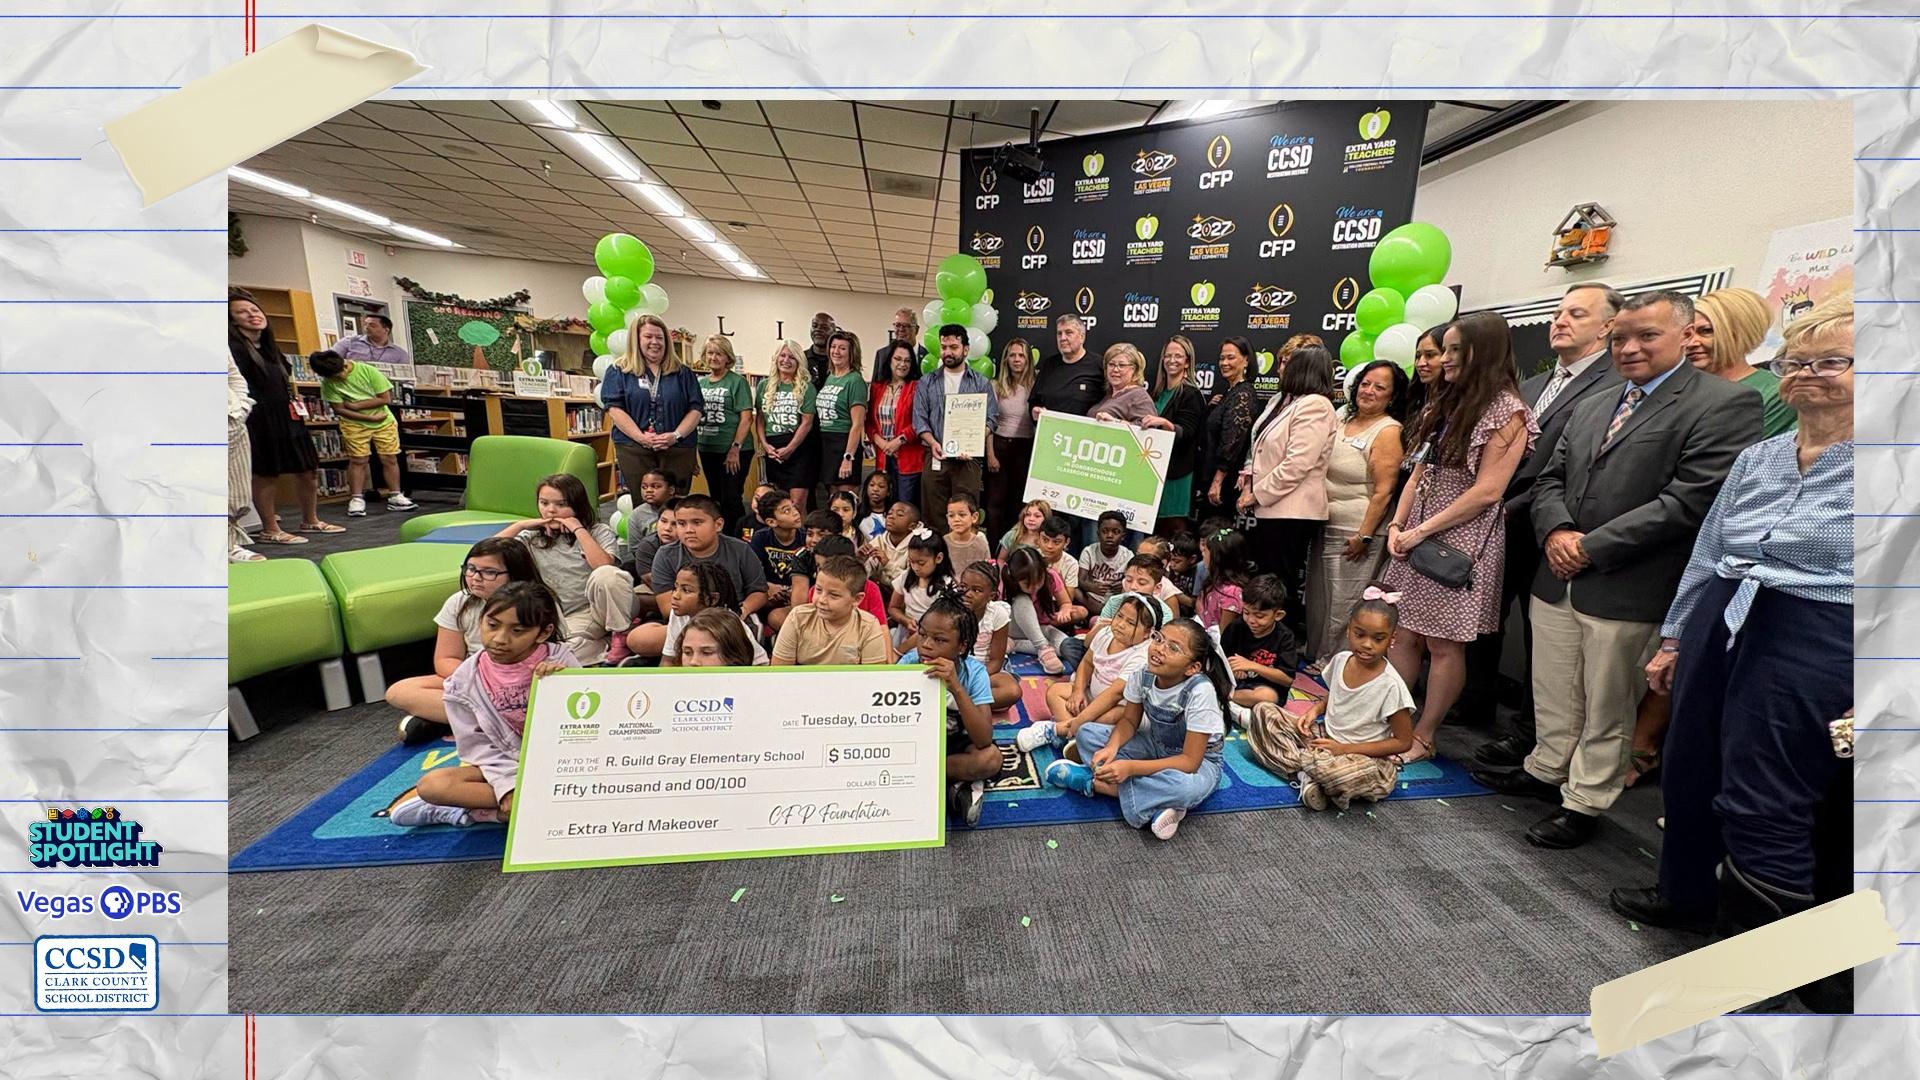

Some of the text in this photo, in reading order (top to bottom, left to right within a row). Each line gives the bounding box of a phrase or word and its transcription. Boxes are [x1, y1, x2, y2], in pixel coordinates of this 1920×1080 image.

[1270, 134, 1306, 147] We are
[1346, 139, 1396, 152] EXTRA YARD
[1268, 144, 1312, 171] CCSD
[1349, 148, 1395, 160] TEACHERS
[1136, 154, 1174, 173] 2027
[1134, 180, 1148, 190] LAS
[1148, 179, 1171, 190] VEGAS
[1200, 170, 1234, 190] CFP
[1024, 178, 1054, 198] CCSD
[1077, 184, 1109, 192] TEACHERS
[976, 196, 1000, 210] CFP
[1336, 206, 1374, 219] We are
[1073, 228, 1088, 240] We
[1192, 220, 1232, 238] 2027
[1332, 218, 1382, 243] CCSD
[973, 238, 1001, 250] 2027
[1072, 239, 1106, 258] CCSD
[1148, 240, 1164, 248] YARD
[1190, 247, 1204, 256] LAS
[1204, 246, 1229, 255] VEGAS
[1259, 239, 1296, 258] CFP
[352, 251, 366, 264] EXIT
[1130, 247, 1163, 256] TEACHERS
[1806, 248, 1838, 260] WILD
[1022, 254, 1048, 270] CFP
[1018, 298, 1048, 310] 2027
[1124, 292, 1138, 302] We
[1250, 292, 1294, 306] 2027
[454, 307, 501, 320] READING
[1124, 304, 1158, 322] CCSD
[1264, 316, 1290, 324] VEGAS
[717, 316, 735, 336] L
[1080, 316, 1097, 330] FP
[1322, 314, 1357, 330] CFP
[1196, 370, 1214, 388] SD
[702, 388, 728, 396] REAT
[1052, 432, 1126, 468] $1,000
[1056, 466, 1122, 485] CLASSROOM RESOURCES
[1233, 516, 1258, 530] FP
[769, 552, 793, 560] GUES
[674, 700, 721, 712] CCSD
[872, 692, 921, 706] 2025
[802, 714, 857, 727] Tuesday,
[860, 713, 911, 724] October
[914, 712, 922, 722] 7
[608, 728, 662, 736] CHAMPIONSHIP
[606, 750, 804, 768] R. Guild Gray Elementary School
[828, 747, 890, 764] $ 50,000
[553, 776, 746, 797] Fifty thousand and 00/100
[818, 801, 891, 823] Foundation
[568, 823, 607, 836] Extra
[612, 820, 644, 832] Yard
[648, 818, 719, 831] Makeover
